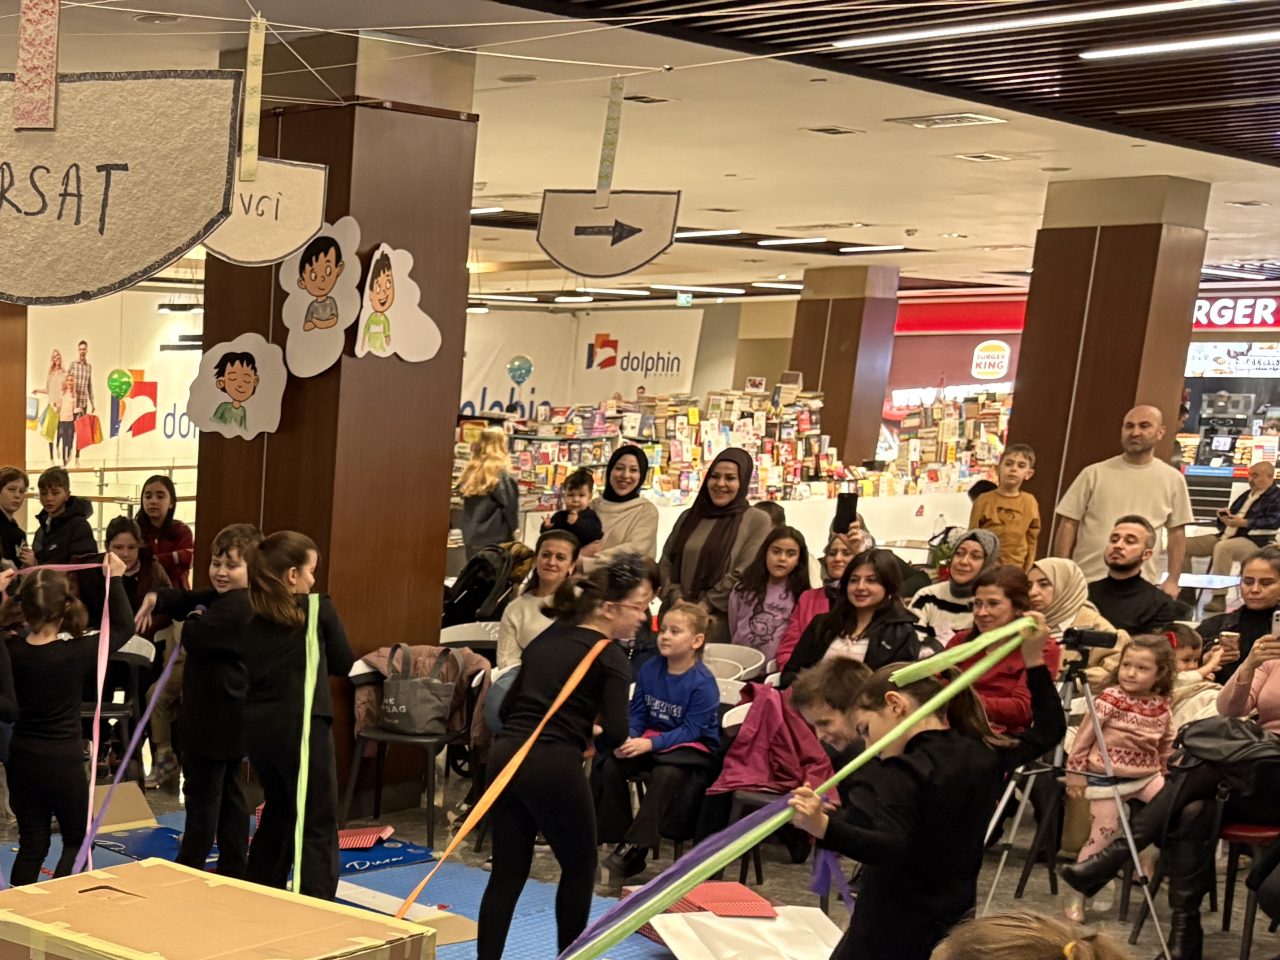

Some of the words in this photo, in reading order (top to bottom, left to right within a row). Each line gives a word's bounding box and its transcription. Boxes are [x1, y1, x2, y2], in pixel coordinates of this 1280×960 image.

[1192, 297, 1277, 326] RGER
[620, 350, 681, 379] dolphin
[975, 360, 1004, 370] KING
